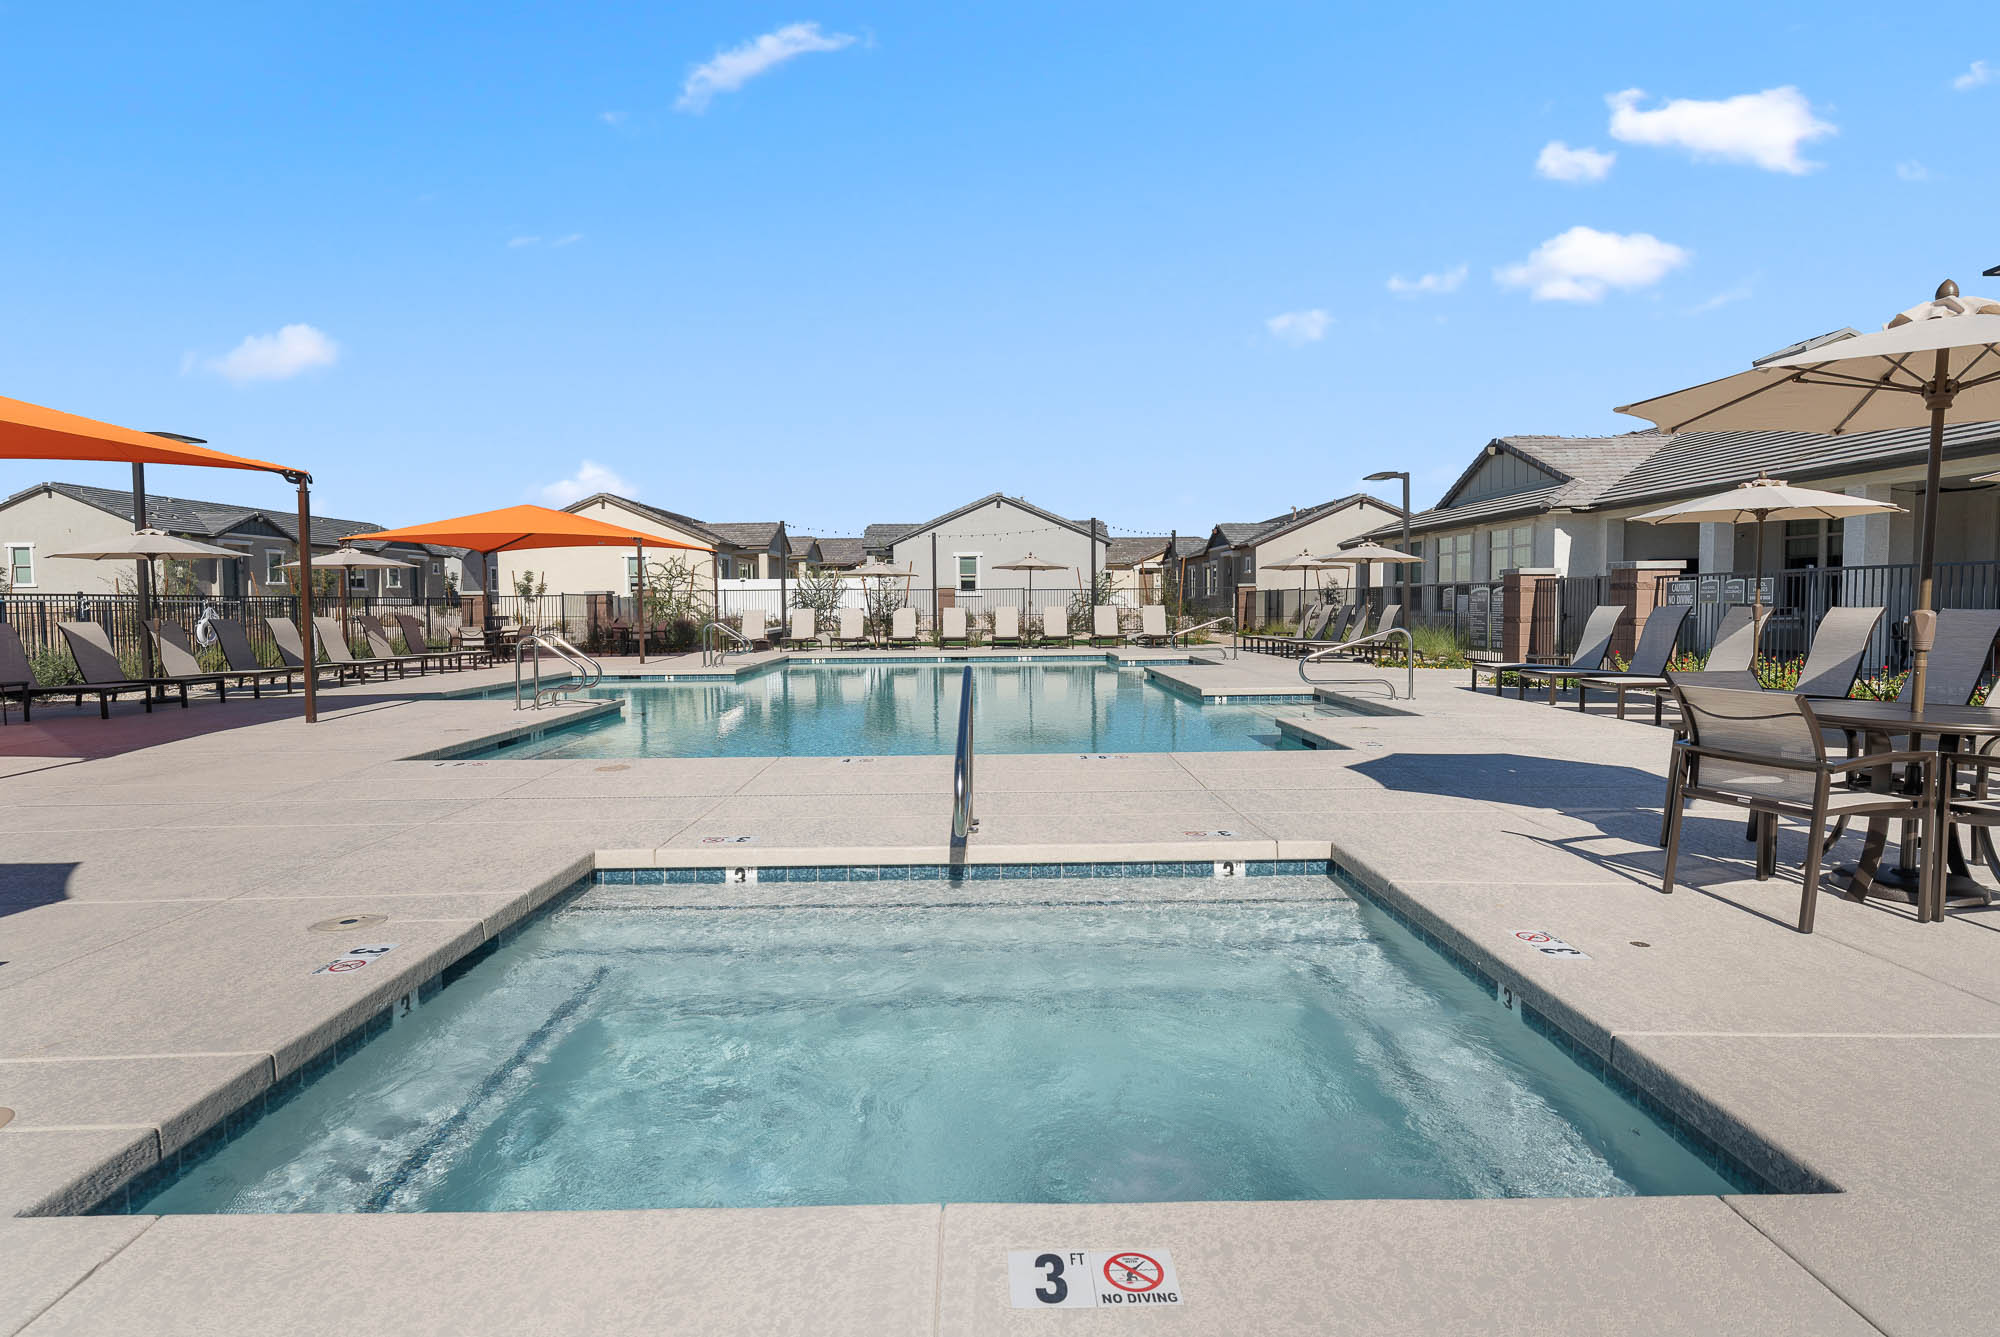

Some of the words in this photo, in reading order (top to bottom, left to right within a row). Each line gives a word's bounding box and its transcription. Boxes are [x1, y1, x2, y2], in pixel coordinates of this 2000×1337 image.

[1671, 584, 1691, 592] CAUTION
[1667, 594, 1676, 605] NO
[1676, 594, 1694, 605] DIVING
[1034, 1253, 1068, 1304] 3
[1069, 1252, 1085, 1265] FT
[1101, 1293, 1123, 1304] NO
[1126, 1292, 1178, 1303] DIVING
